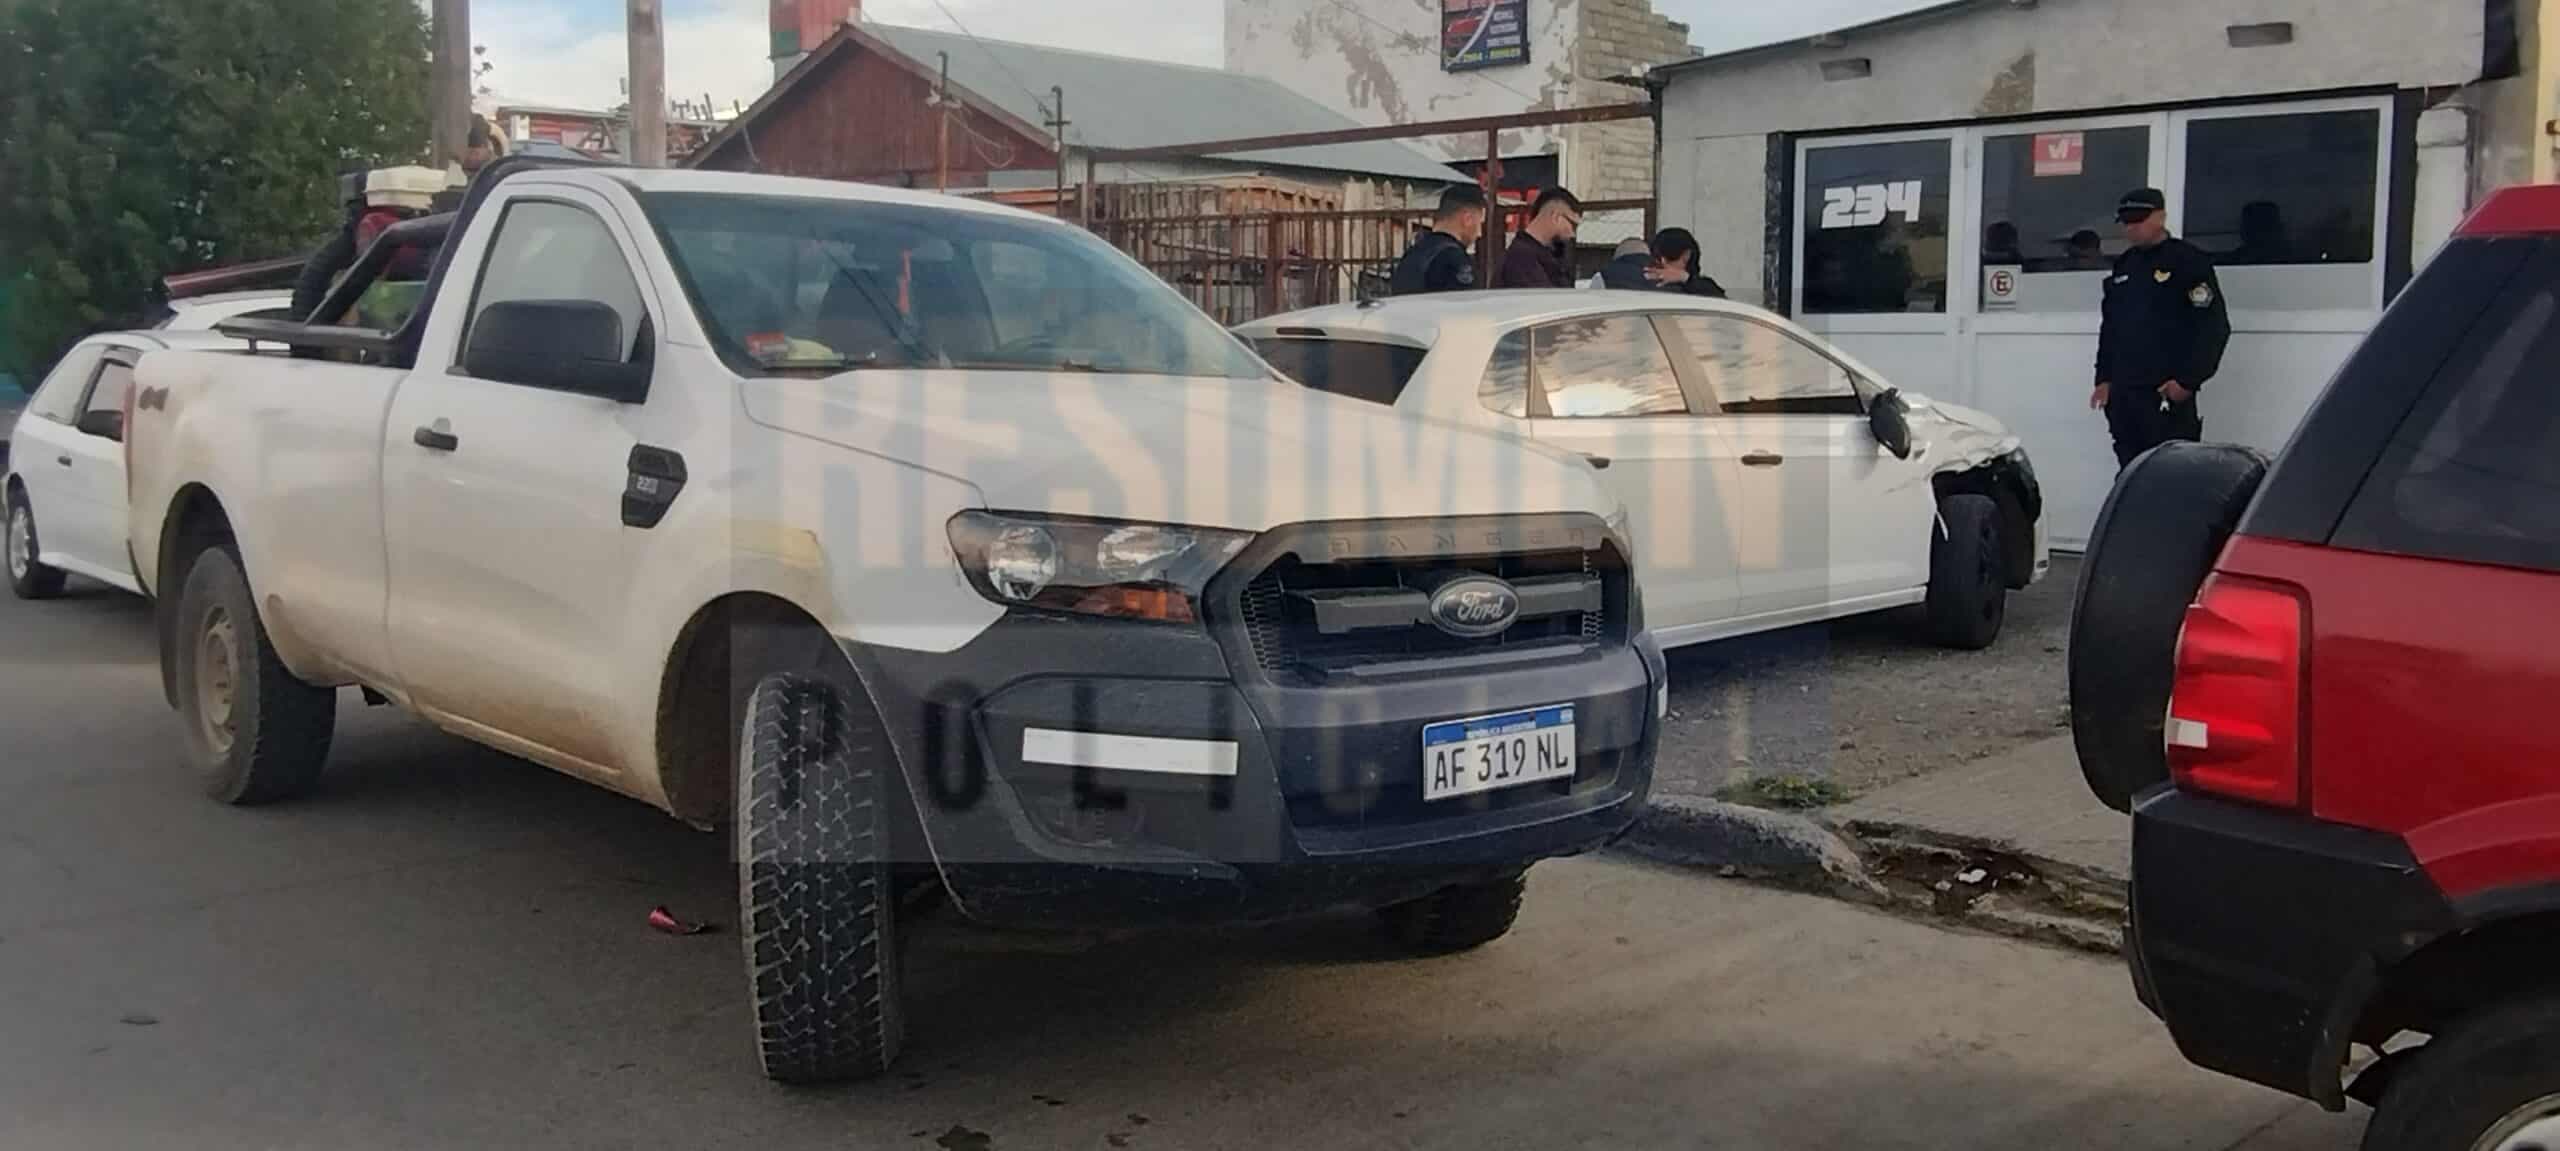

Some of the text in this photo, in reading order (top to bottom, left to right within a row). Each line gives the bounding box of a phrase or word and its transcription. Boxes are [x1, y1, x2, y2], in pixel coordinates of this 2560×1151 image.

[1821, 180, 1922, 229] 234
[1457, 591, 1505, 620] Ford
[1433, 732, 1569, 791] AF 319 NL
